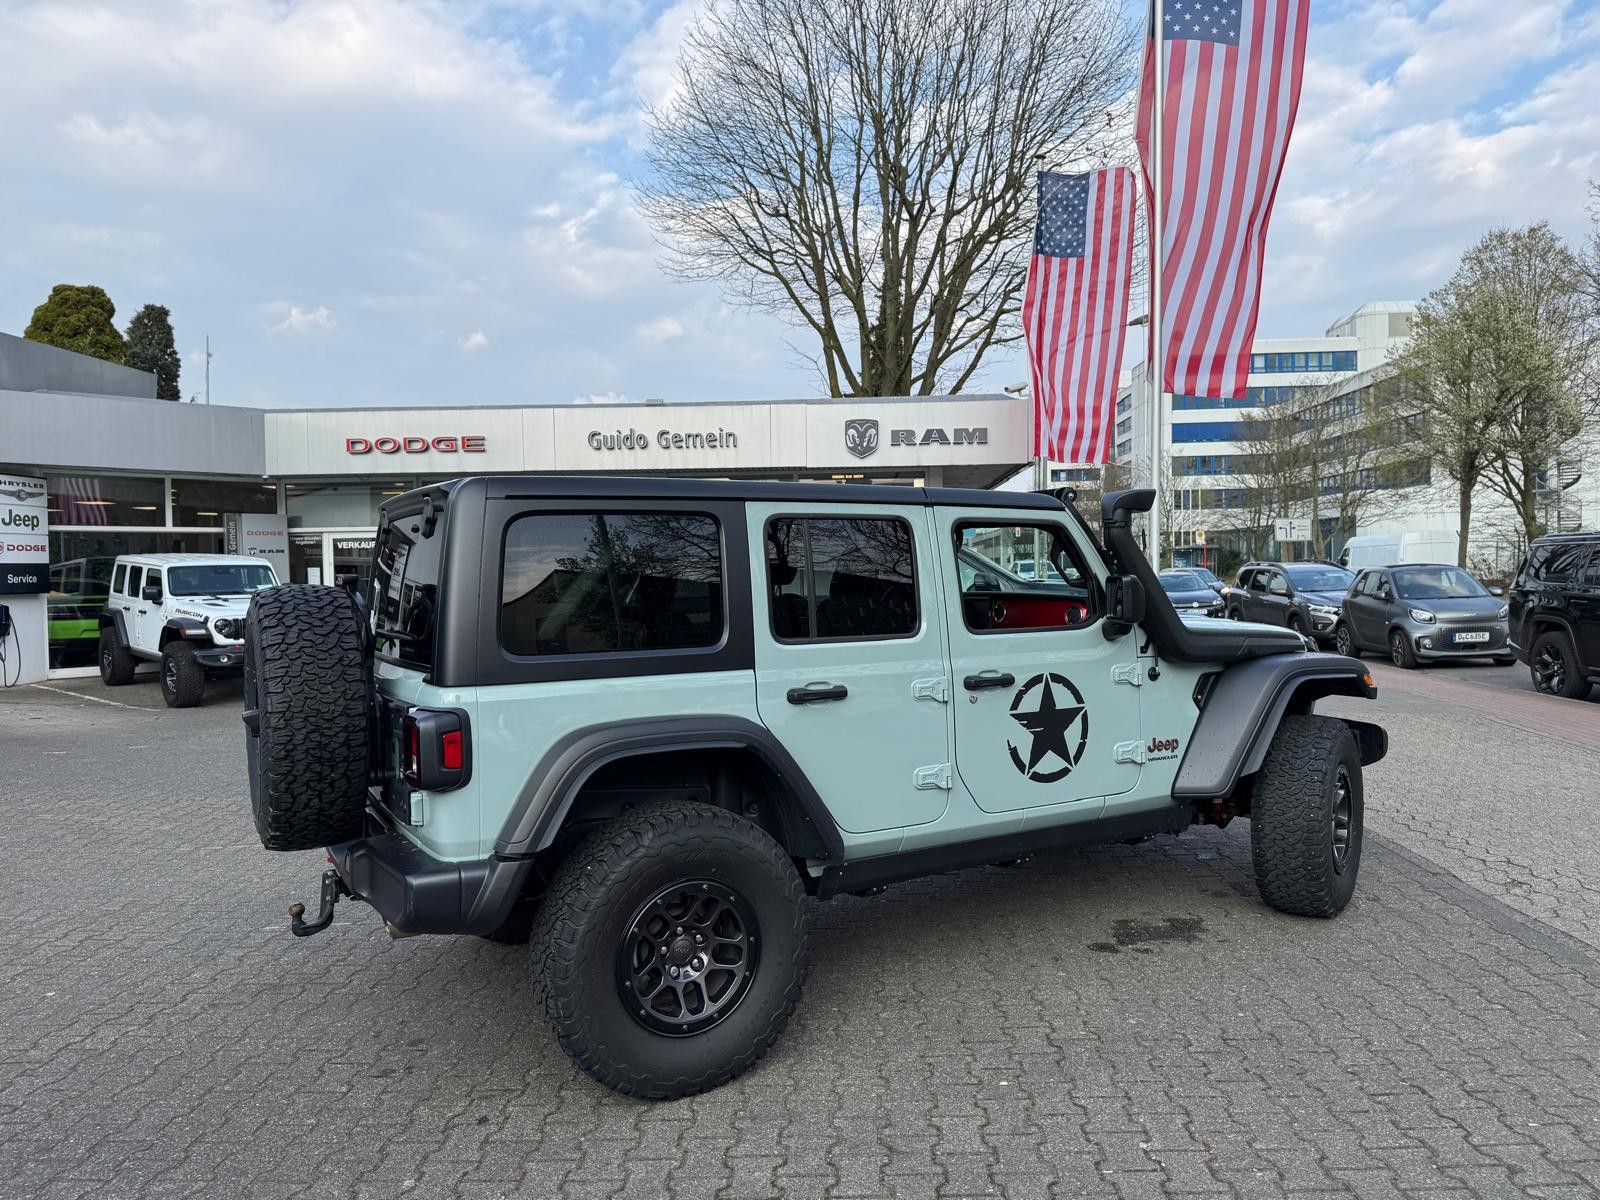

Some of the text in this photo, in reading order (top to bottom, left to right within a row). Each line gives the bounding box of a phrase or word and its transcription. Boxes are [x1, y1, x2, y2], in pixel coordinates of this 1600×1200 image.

[588, 427, 738, 450] Guido Gemein
[890, 427, 988, 446] RAM
[346, 436, 486, 454] DODGE
[0, 480, 44, 489] HRYSLER
[2, 509, 40, 531] Jeep
[7, 544, 47, 552] DODGE
[337, 541, 376, 549] VERKAUF
[7, 574, 38, 584] Service
[1147, 737, 1178, 753] Jeep
